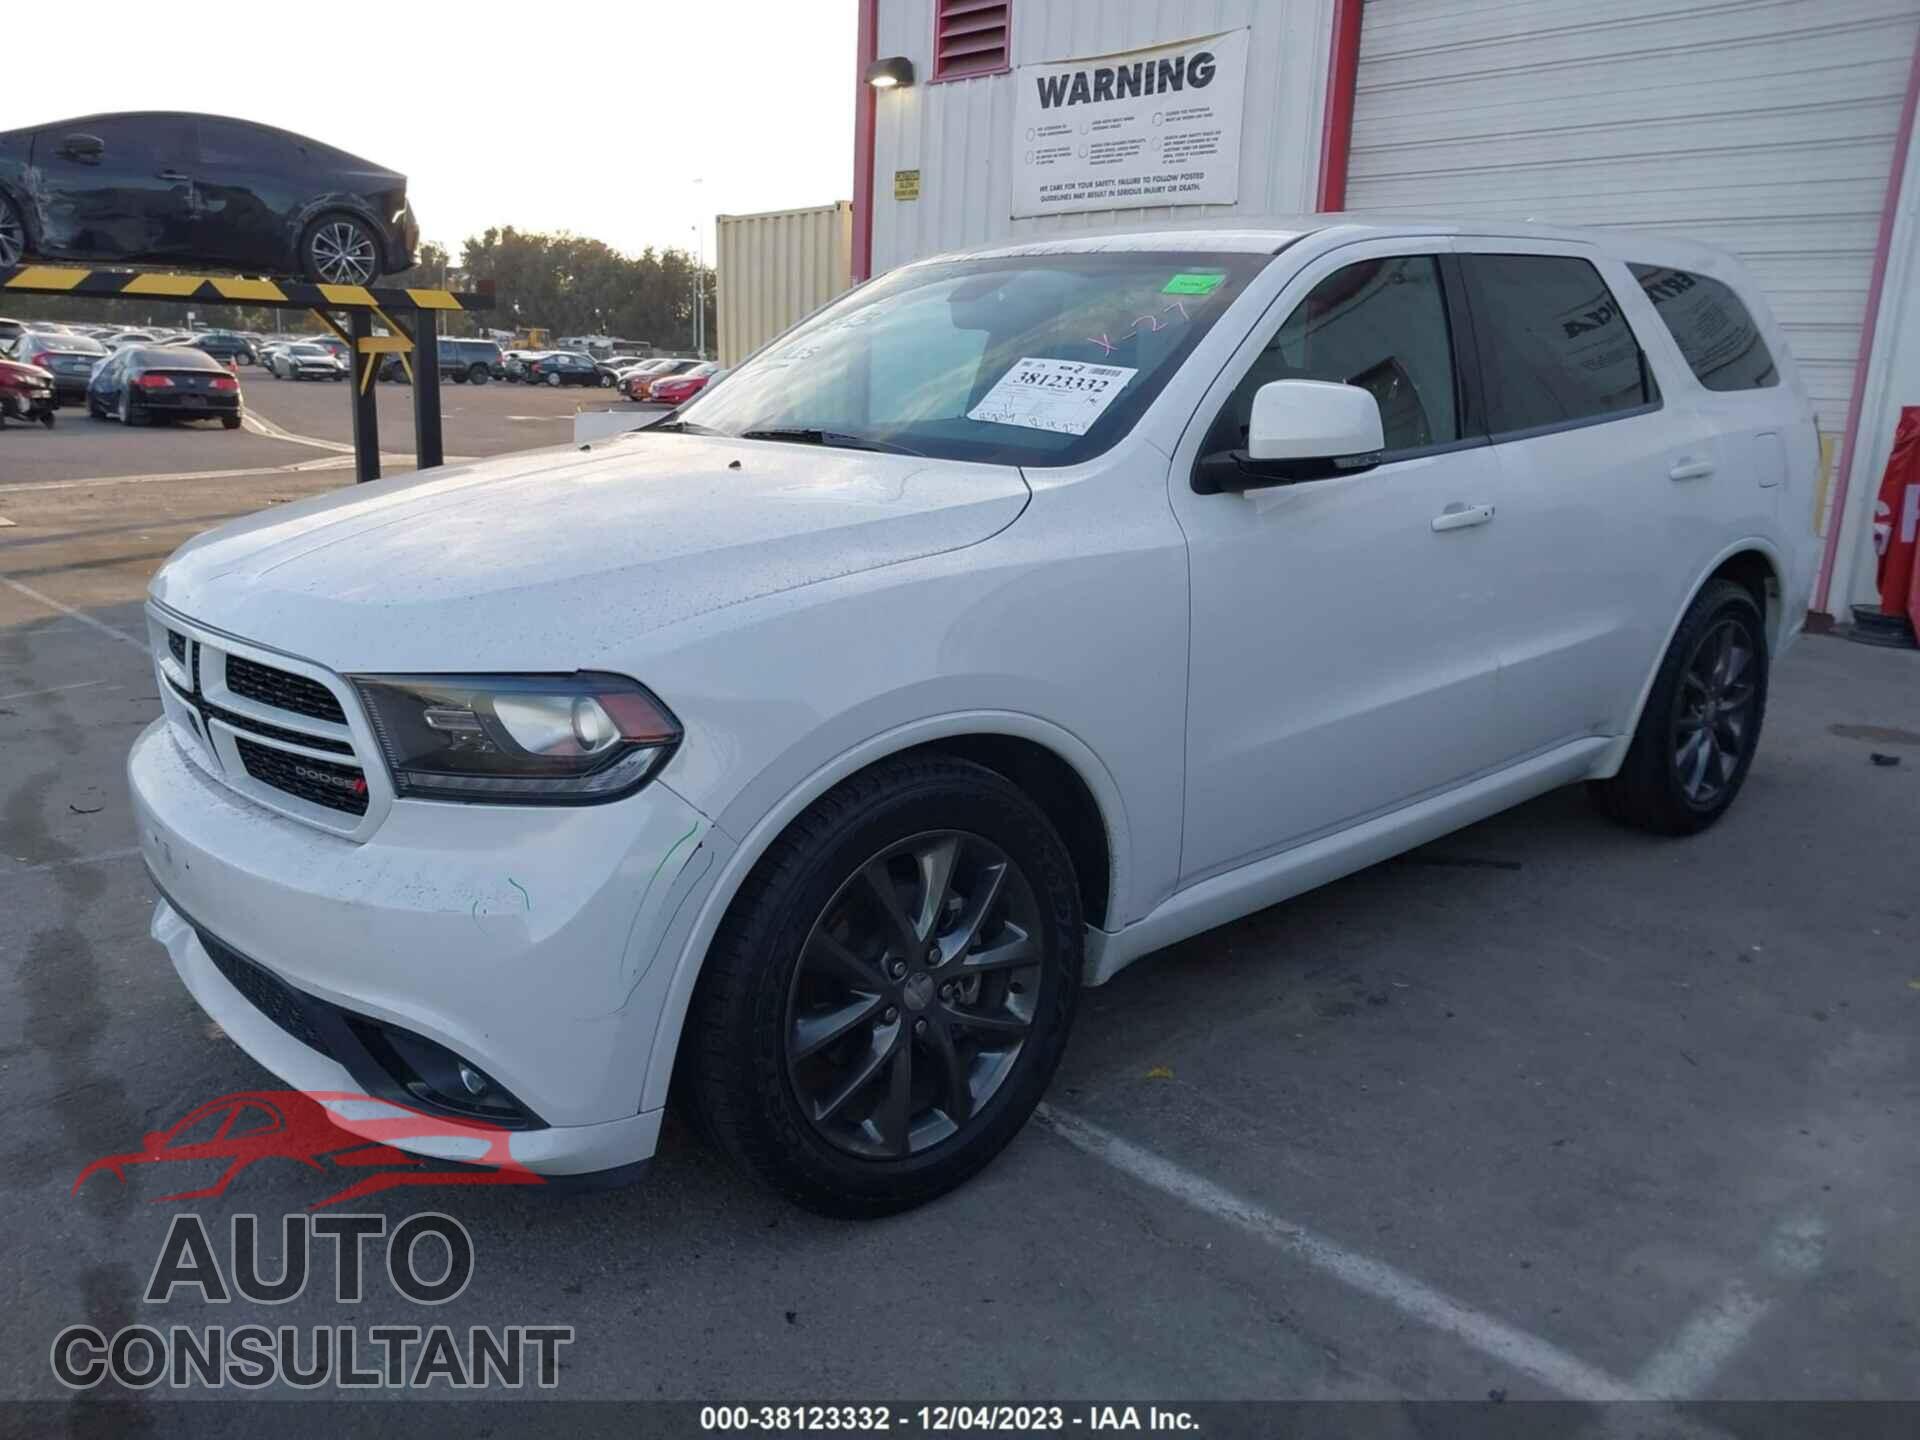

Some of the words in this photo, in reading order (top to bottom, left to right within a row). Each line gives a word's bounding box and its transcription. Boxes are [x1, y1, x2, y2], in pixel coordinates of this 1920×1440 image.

[1036, 52, 1217, 109] WARNING
[1152, 174, 1178, 182] FOLLOW
[1180, 172, 1205, 180] POSTED
[1167, 184, 1178, 192] OR
[1013, 371, 1109, 393] 38123332
[295, 765, 356, 790] DODGE
